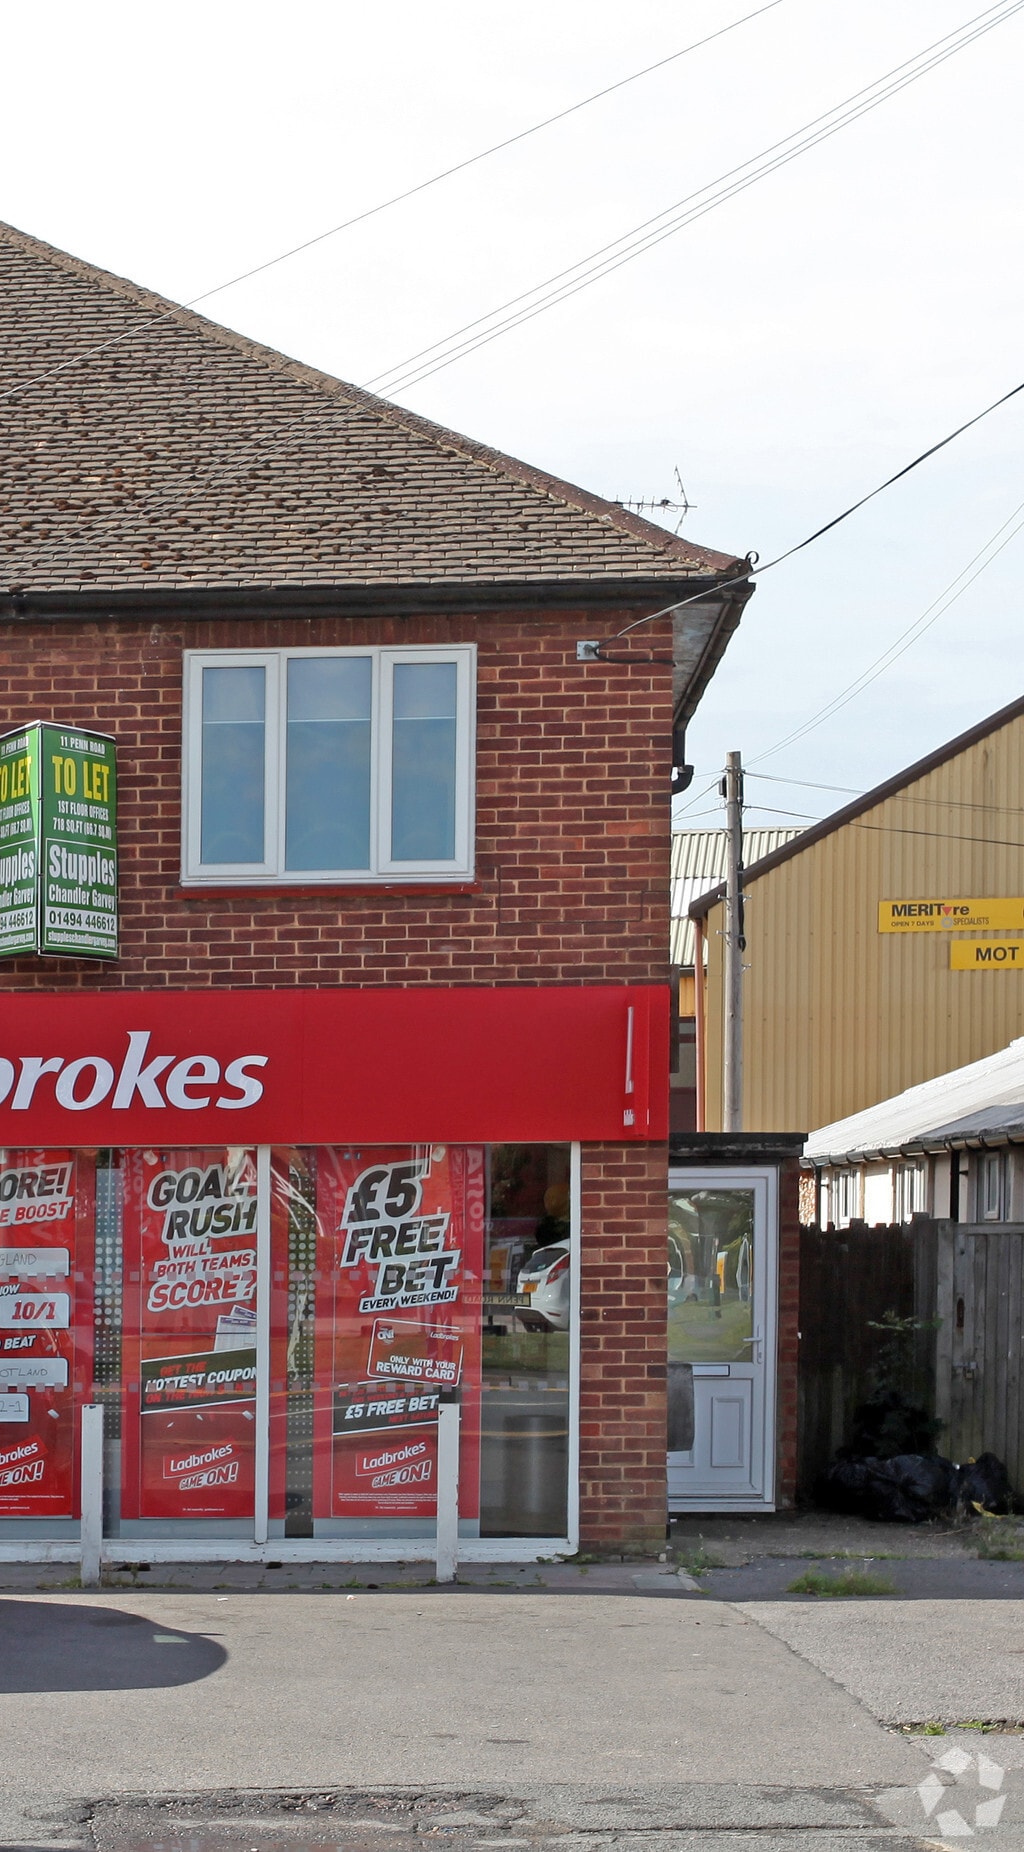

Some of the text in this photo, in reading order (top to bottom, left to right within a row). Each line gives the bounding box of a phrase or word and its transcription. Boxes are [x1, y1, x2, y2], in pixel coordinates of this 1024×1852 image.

[60, 736, 105, 755] 11 PENN ROAD
[11, 756, 32, 799] LET
[52, 755, 109, 802] TO LET
[58, 800, 109, 822] 1ST FLOOR OFFICES
[53, 817, 64, 832] 718
[66, 818, 83, 834] SQ.FT
[49, 844, 115, 887] Stupples
[13, 887, 34, 905] Garvey
[48, 884, 115, 911] Chandler Garvey
[8, 911, 34, 928] 446612
[49, 910, 115, 932] 01494 446612
[953, 917, 989, 926] SPECIALISTS
[976, 946, 1020, 961] MOT
[347, 1164, 424, 1222] £5
[14, 1201, 69, 1221] BOOST
[166, 1200, 257, 1240] RUSH
[172, 1242, 208, 1258] WILL
[345, 1217, 445, 1262] FREE
[157, 1253, 251, 1278] BOTH TEAMS
[380, 1256, 454, 1296] BET
[151, 1269, 257, 1308] SCORE?
[362, 1289, 455, 1310] EVERY WEEKEND!
[11, 1301, 57, 1320] 10/1
[4, 1335, 37, 1350] BEAT
[430, 1331, 460, 1341] Ladbrokes
[376, 1361, 455, 1380] REWARD CARD
[389, 1355, 456, 1371] ONLY WITH YOUR
[344, 1403, 365, 1420] £5
[367, 1398, 406, 1417] FREE
[408, 1394, 440, 1412] BET
[170, 1443, 233, 1472] Ladbrokes
[362, 1441, 426, 1470] Ladbrokes
[11, 1460, 45, 1485] ON!
[179, 1461, 239, 1490] GAME ON!
[372, 1459, 432, 1488] GAME ON!
